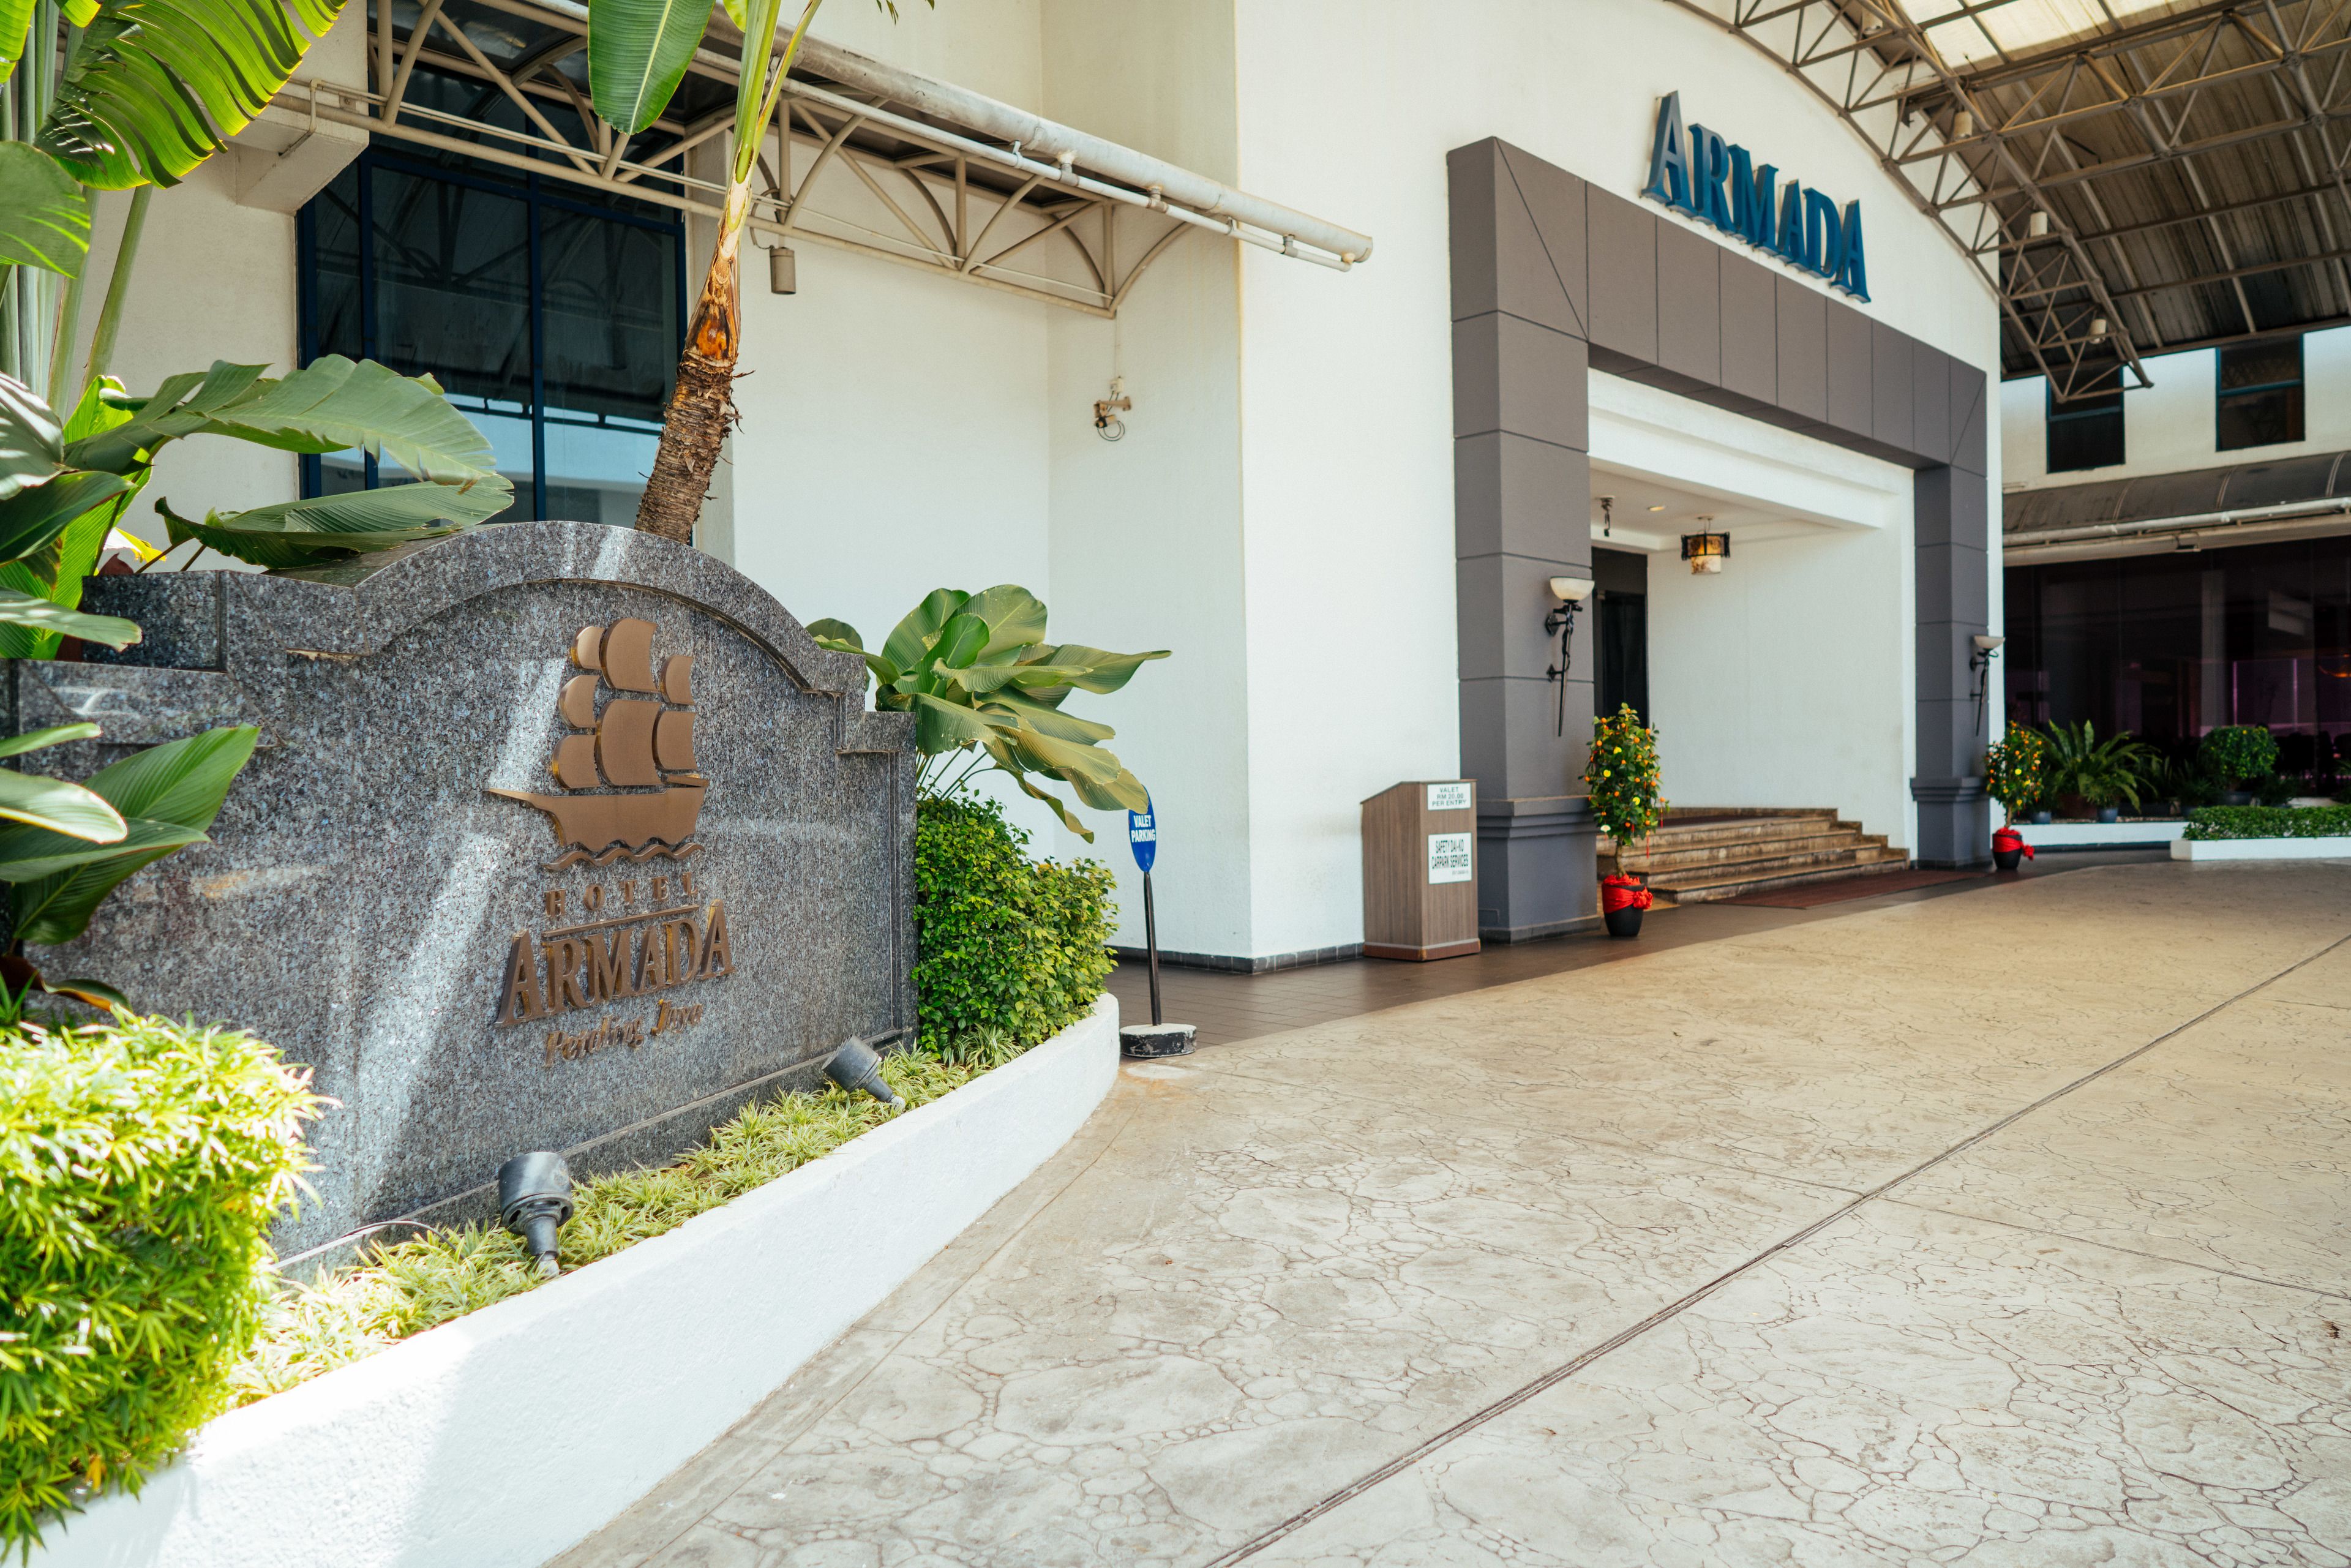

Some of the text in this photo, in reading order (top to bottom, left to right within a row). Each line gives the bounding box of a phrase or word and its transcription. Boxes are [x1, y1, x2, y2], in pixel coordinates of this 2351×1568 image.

[1640, 90, 1872, 304] ARMADA
[1131, 828, 1156, 843] PARKING
[1133, 815, 1151, 828] VALET
[1431, 854, 1468, 869] CARPARK SERVICES
[1436, 840, 1450, 853] SAFETY
[544, 872, 699, 918] HOTEL
[493, 898, 735, 1028] ARMADA
[542, 999, 703, 1068] Petaling Jaya
